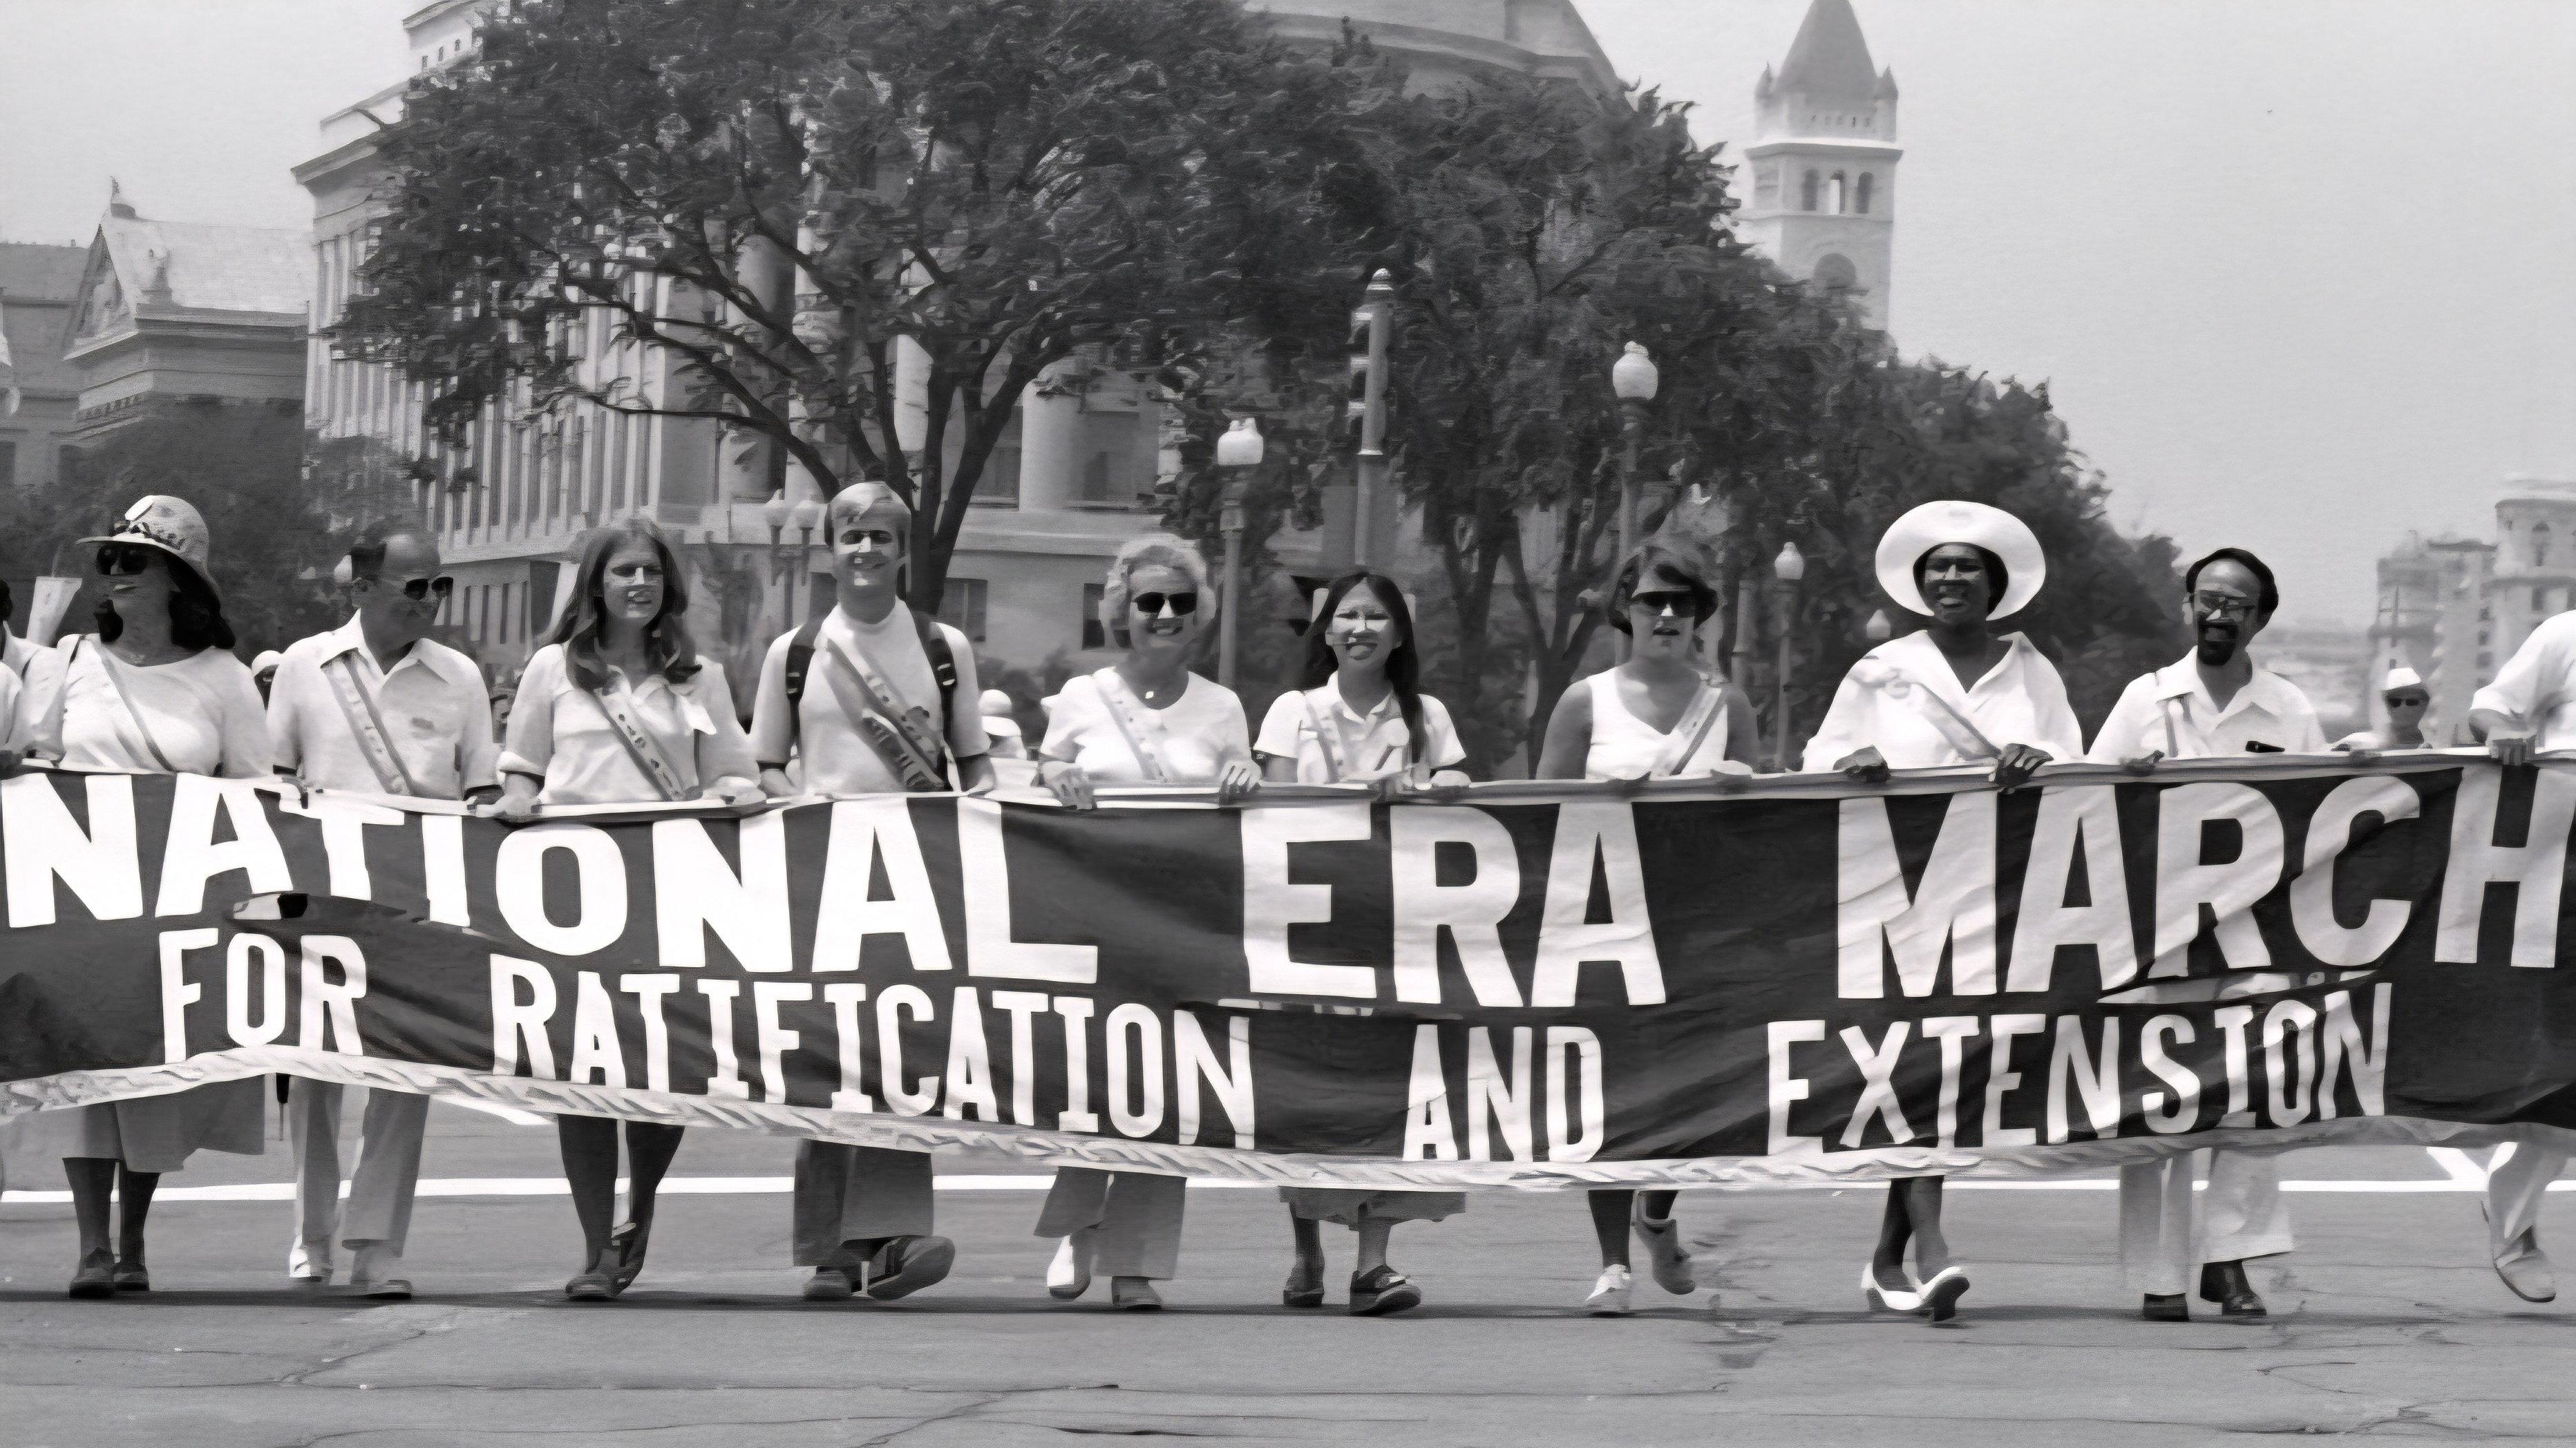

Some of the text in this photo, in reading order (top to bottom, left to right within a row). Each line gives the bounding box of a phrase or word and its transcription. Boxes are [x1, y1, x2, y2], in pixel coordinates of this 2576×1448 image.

[1, 767, 2575, 1008] NATIONAL ERA MARCH
[159, 928, 2392, 1163] FOR RATIFICATION AND EXTENSION
